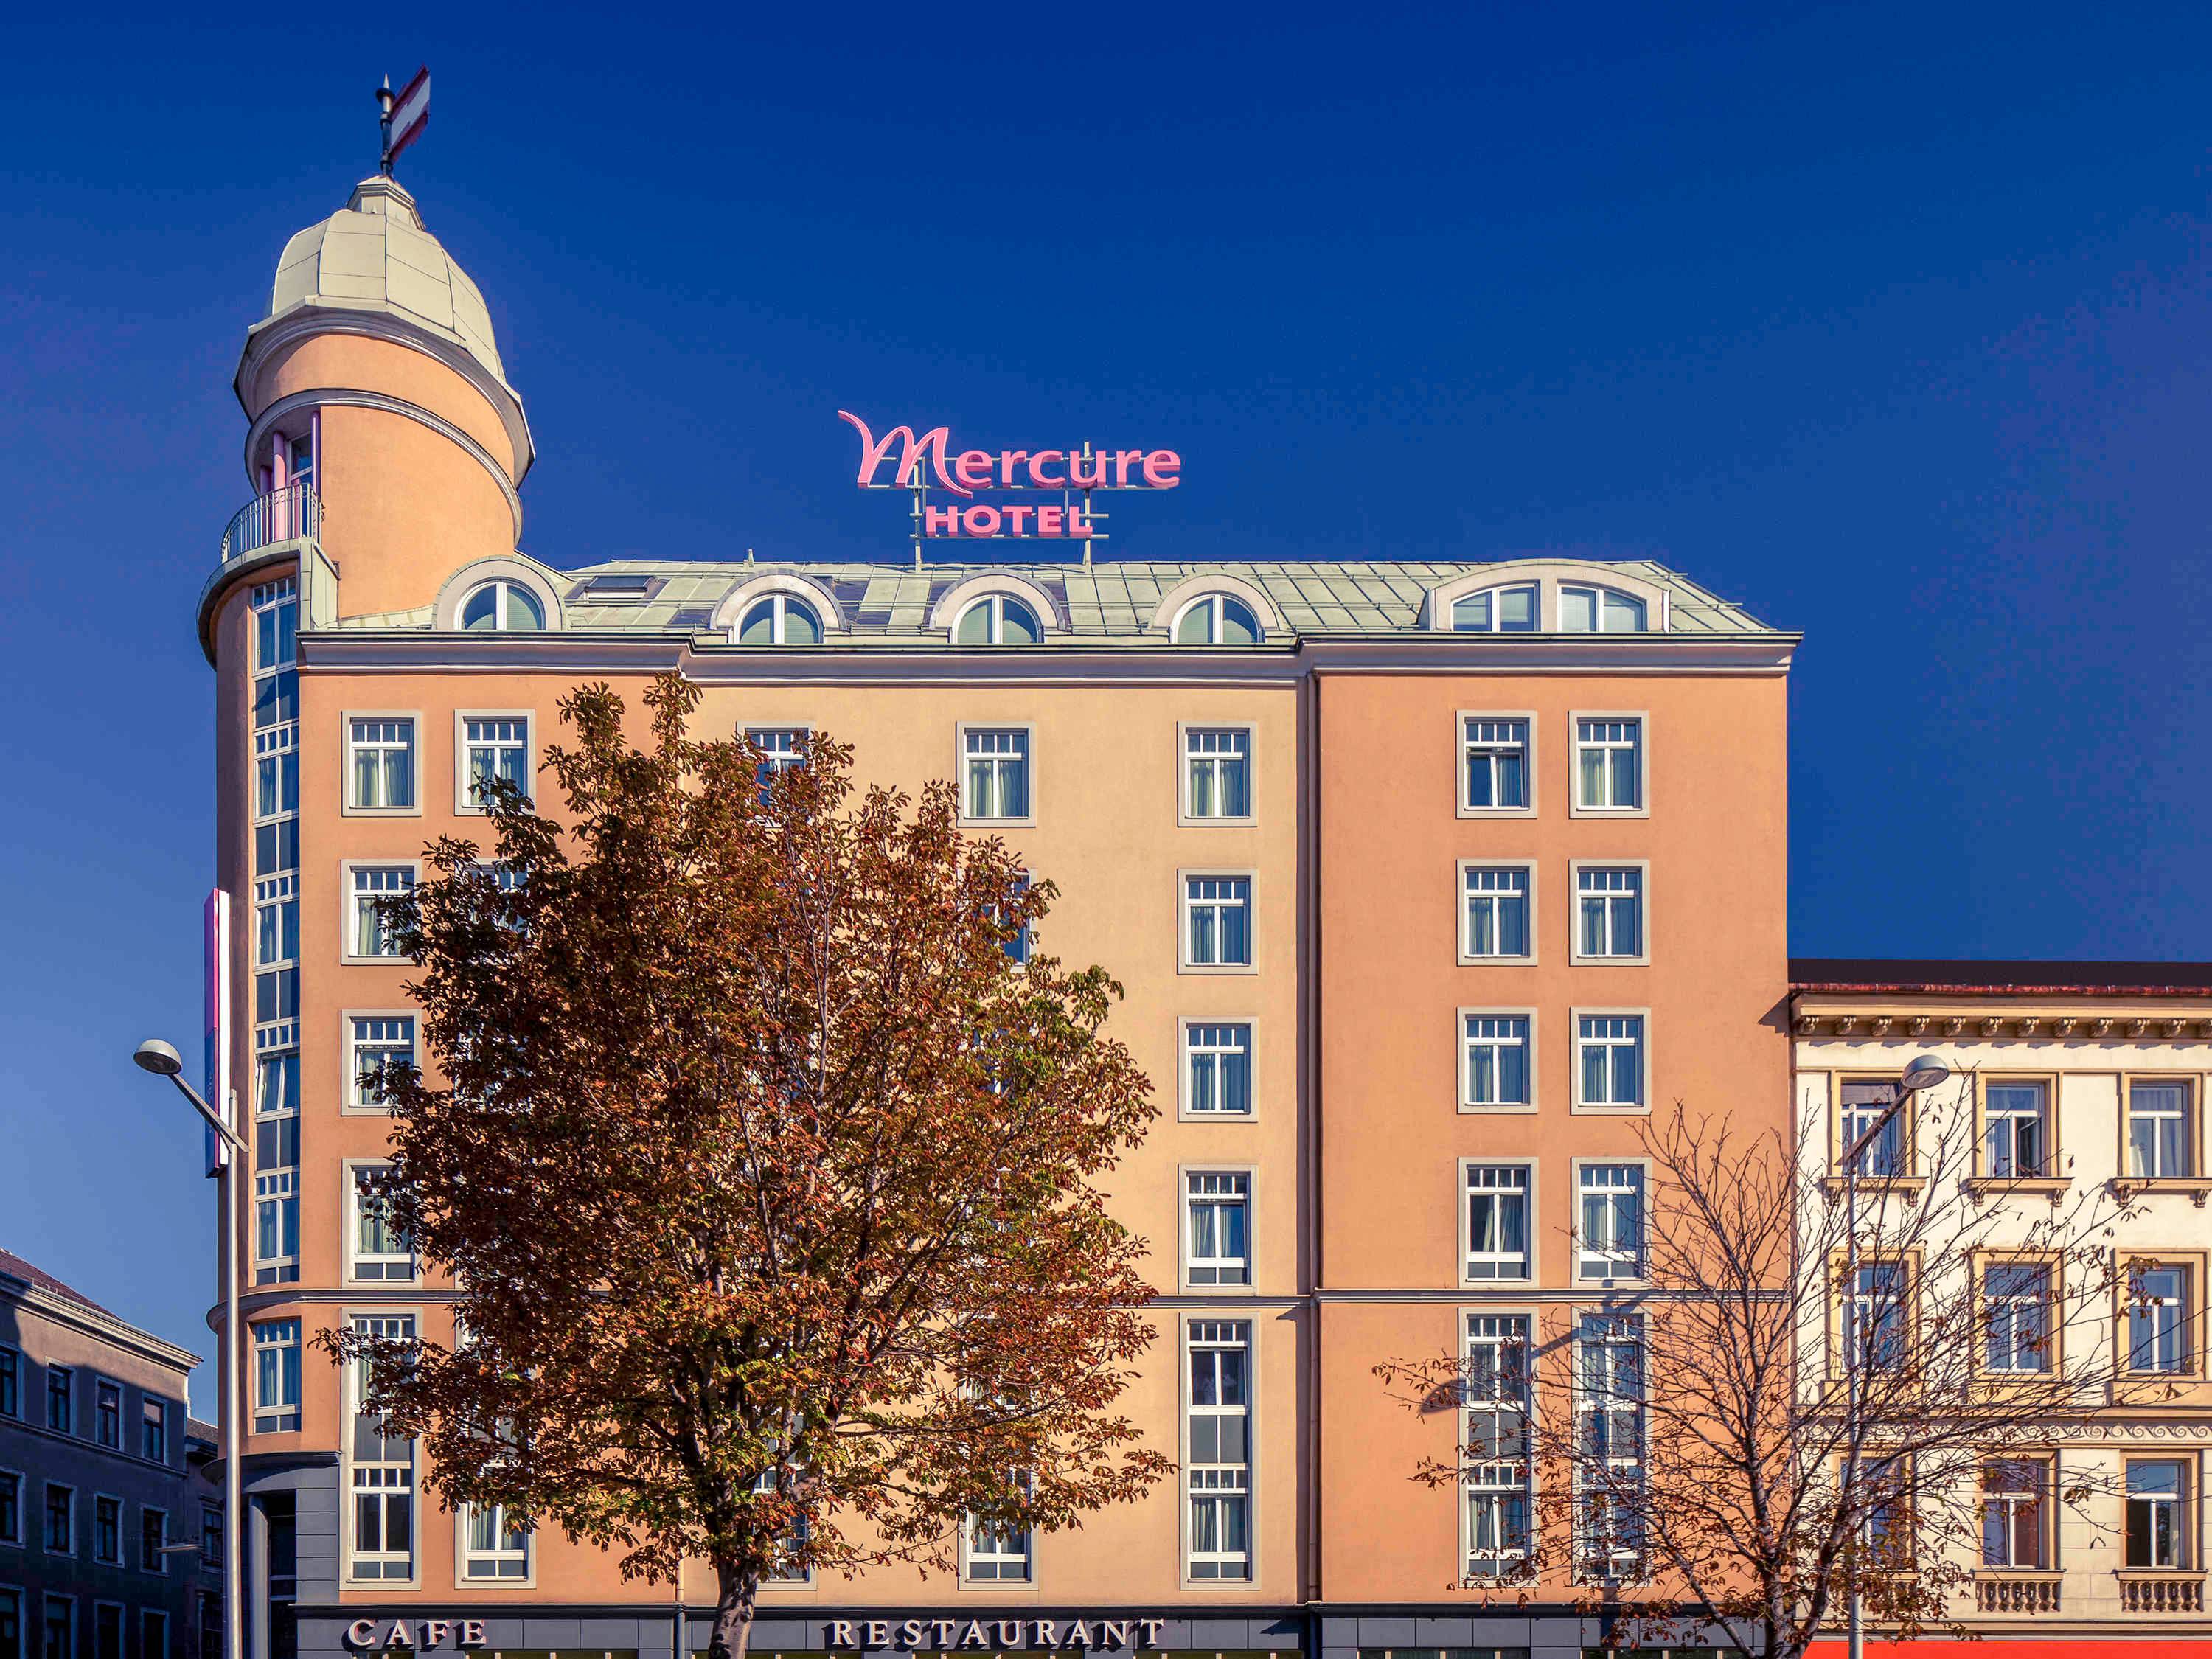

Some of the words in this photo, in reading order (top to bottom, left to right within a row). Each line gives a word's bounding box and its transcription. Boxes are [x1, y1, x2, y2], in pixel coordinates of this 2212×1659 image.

[837, 410, 1181, 499] Mercure
[925, 505, 1093, 537] HOTEL
[348, 1618, 488, 1646] CAFE
[832, 1618, 1164, 1646] RESTAURANT
